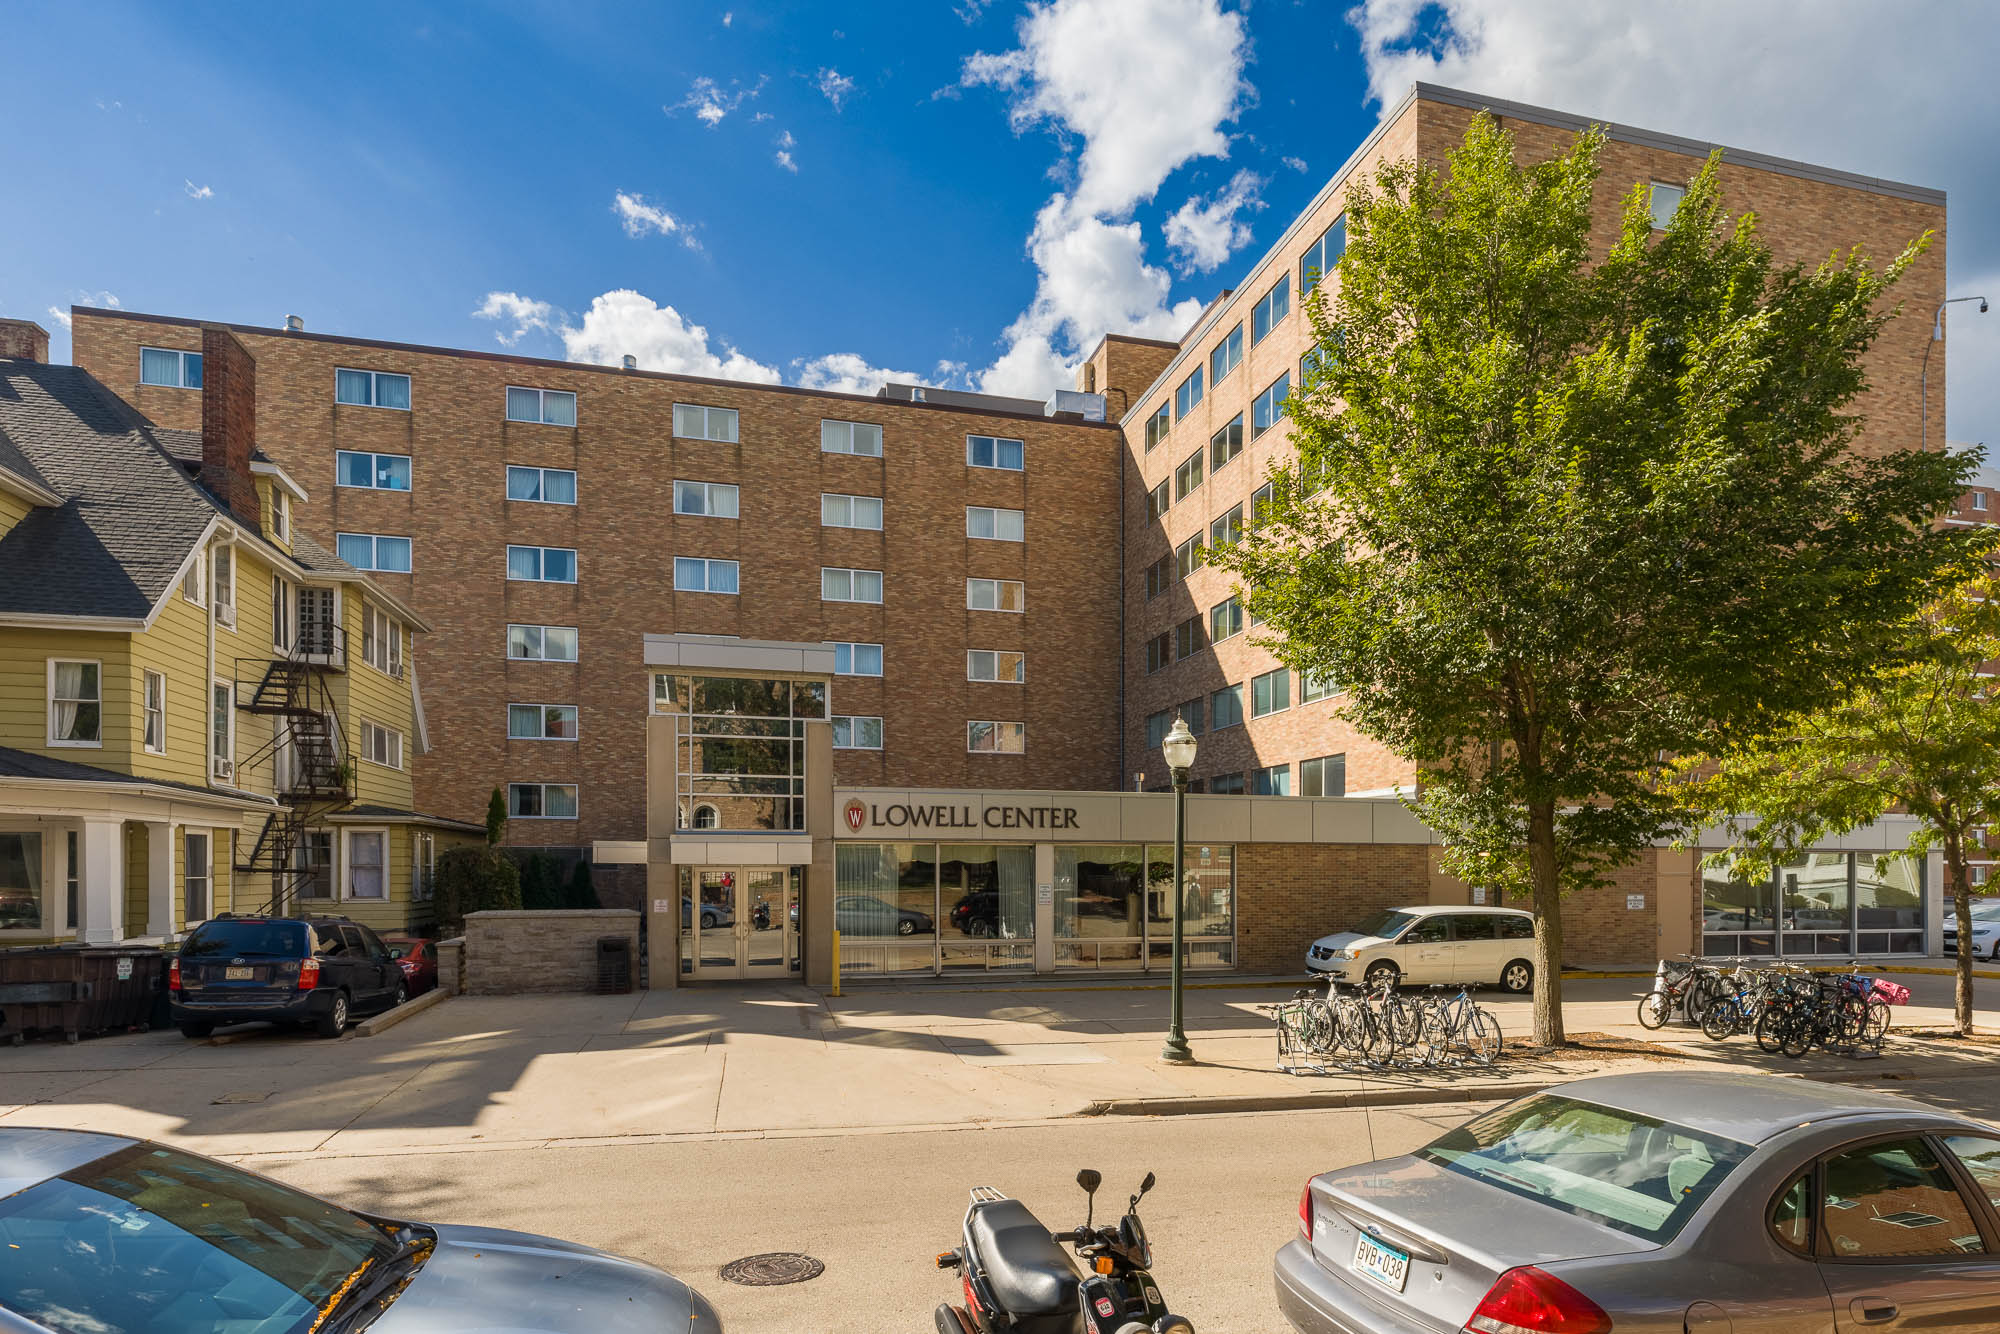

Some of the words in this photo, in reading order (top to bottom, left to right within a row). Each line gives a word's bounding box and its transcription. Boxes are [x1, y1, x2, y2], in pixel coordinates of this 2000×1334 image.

[849, 810, 862, 827] W
[872, 804, 978, 828] LOWELL
[983, 806, 1081, 830] CENTER
[1357, 1241, 1378, 1267] BVB
[1382, 1254, 1403, 1280] 038
